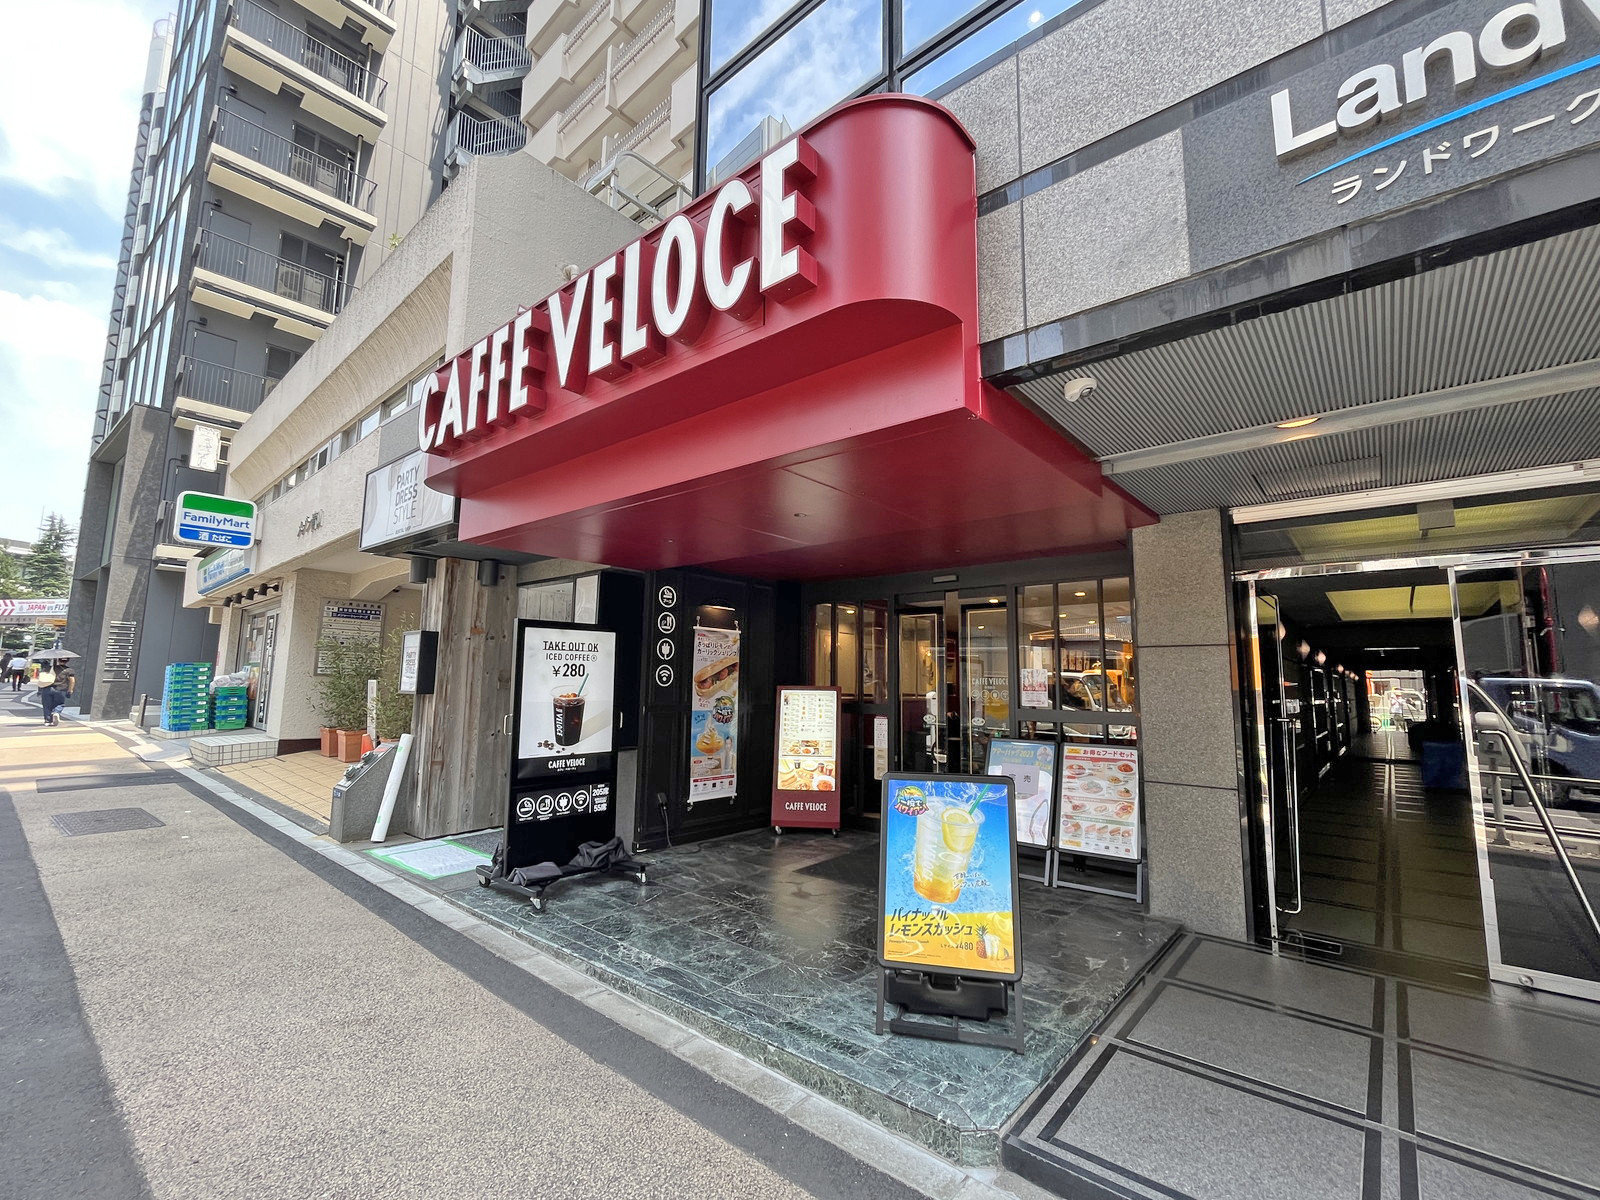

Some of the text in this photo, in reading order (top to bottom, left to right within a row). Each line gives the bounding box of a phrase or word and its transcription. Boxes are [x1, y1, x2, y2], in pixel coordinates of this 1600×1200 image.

[1271, 0, 1600, 158] Land
[418, 137, 802, 453] CAFFE VELOCE
[396, 465, 420, 490] PARTY
[395, 483, 418, 507] DRESS
[393, 500, 417, 525] STYLE
[183, 511, 250, 530] FamilyMart
[198, 531, 233, 544] 酒 たばこ
[543, 640, 599, 652] TAKE OUT OK
[546, 652, 590, 662] ICED COFFEE
[552, 663, 585, 677] ¥280
[1083, 749, 1135, 758] お得なフードセット
[548, 757, 586, 769] CAFFE VELOCE
[785, 801, 828, 812] CAFFE VELOCE
[890, 906, 949, 922] パイナップル
[889, 922, 973, 937] レモンスカッシュ
